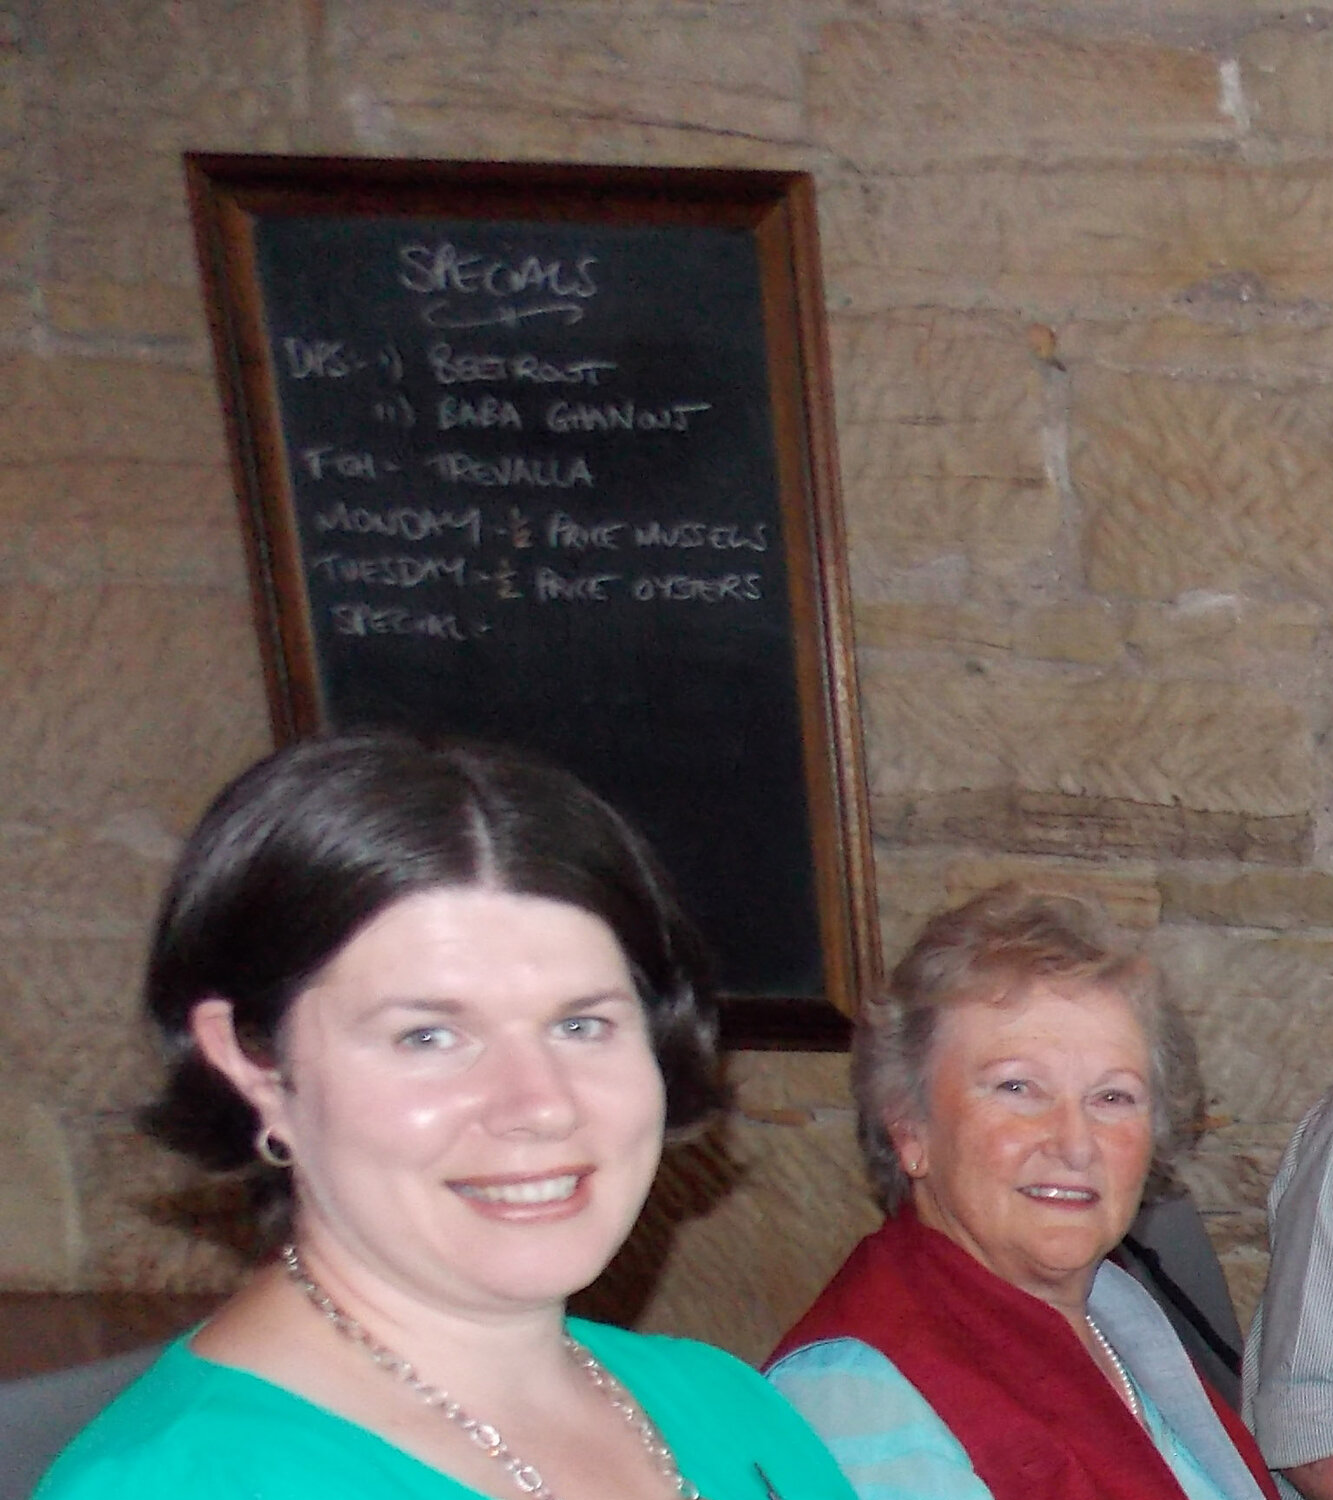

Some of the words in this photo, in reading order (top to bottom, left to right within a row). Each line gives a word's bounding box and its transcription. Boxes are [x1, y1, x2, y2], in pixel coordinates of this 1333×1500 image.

[399, 243, 599, 298] SPECIALS
[438, 396, 522, 432] BABA
[316, 502, 481, 546] MONDAY
[549, 511, 629, 550] PRICE
[635, 521, 768, 552] MUSSELS
[314, 554, 467, 588] TUESDAY
